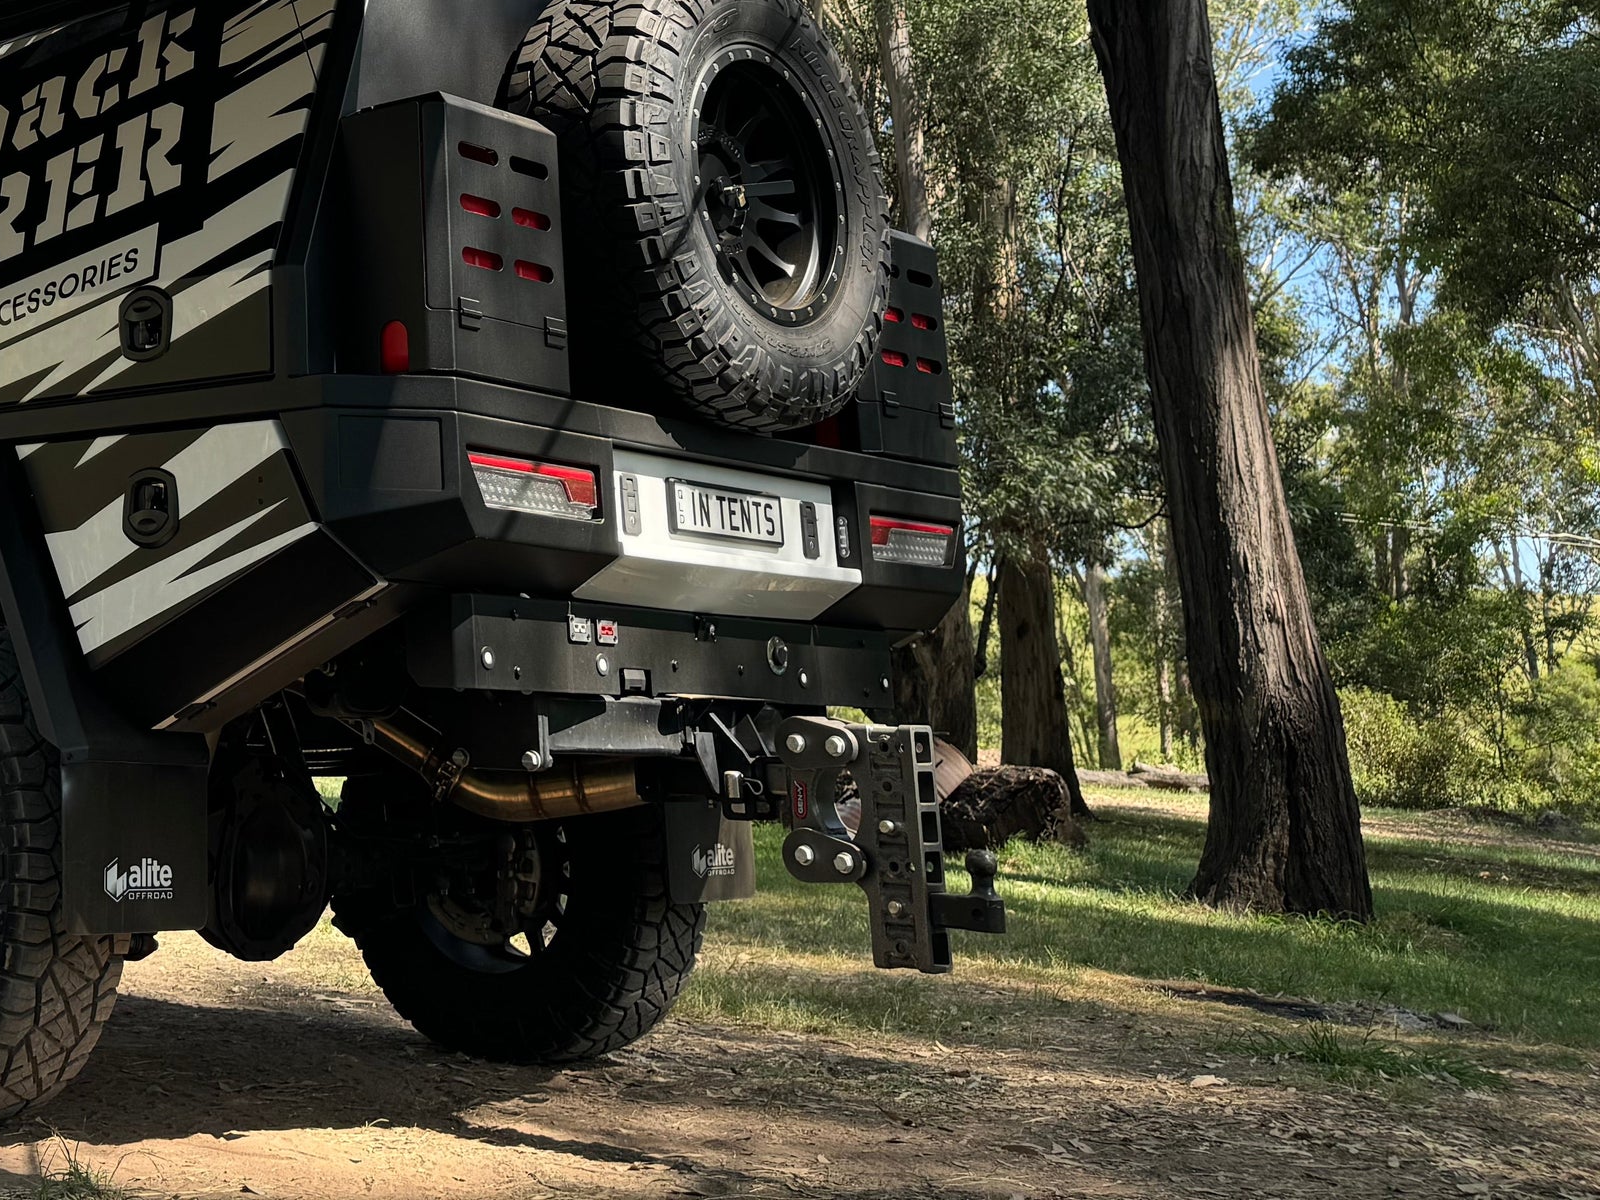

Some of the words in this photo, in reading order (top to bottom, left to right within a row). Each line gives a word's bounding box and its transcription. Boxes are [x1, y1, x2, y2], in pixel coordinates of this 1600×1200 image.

[691, 490, 712, 528] IN
[715, 494, 775, 536] TENTS
[793, 780, 804, 814] GEN-Y
[707, 868, 736, 877] OFFROAD
[128, 892, 174, 900] OFFROAD
